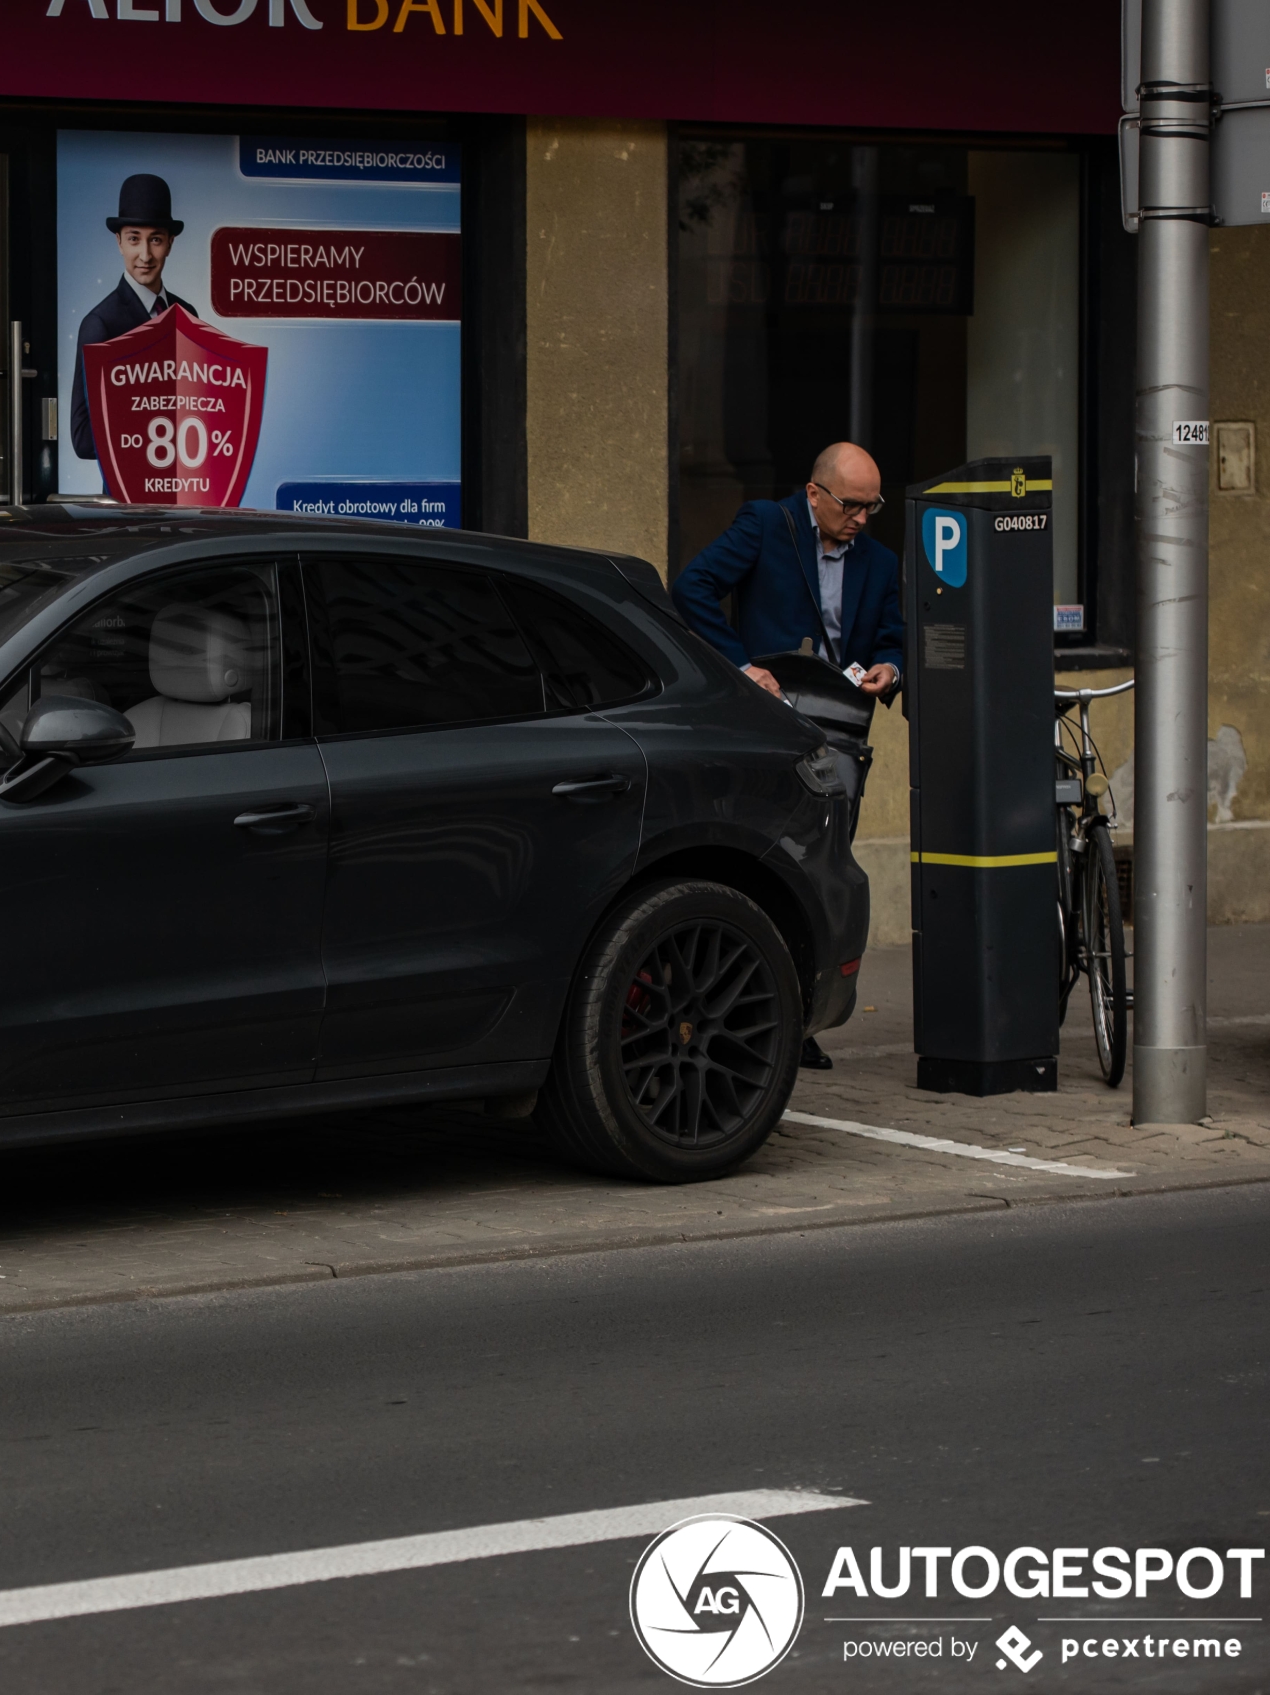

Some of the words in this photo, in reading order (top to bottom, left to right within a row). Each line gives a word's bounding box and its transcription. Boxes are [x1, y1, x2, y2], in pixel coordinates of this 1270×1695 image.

[256, 149, 296, 164] BANK
[299, 150, 446, 169] PRZEDSIĘBIORCZOŚCI
[229, 243, 365, 268] WSPIERAMY
[230, 276, 446, 307] PRZEDSIĘBIORCÓW
[110, 360, 246, 389] GWARANCJA
[131, 396, 226, 412] ZABEZPIECZA
[121, 434, 143, 448] DO
[146, 416, 233, 469] 80%
[1176, 424, 1209, 441] 12481
[144, 478, 210, 492] KREDYTU
[293, 500, 335, 514] Kredyt
[338, 500, 397, 516] obrotowy
[400, 499, 418, 513] dla
[422, 499, 446, 513] firm
[994, 514, 1047, 531] G040817
[935, 517, 961, 571] P
